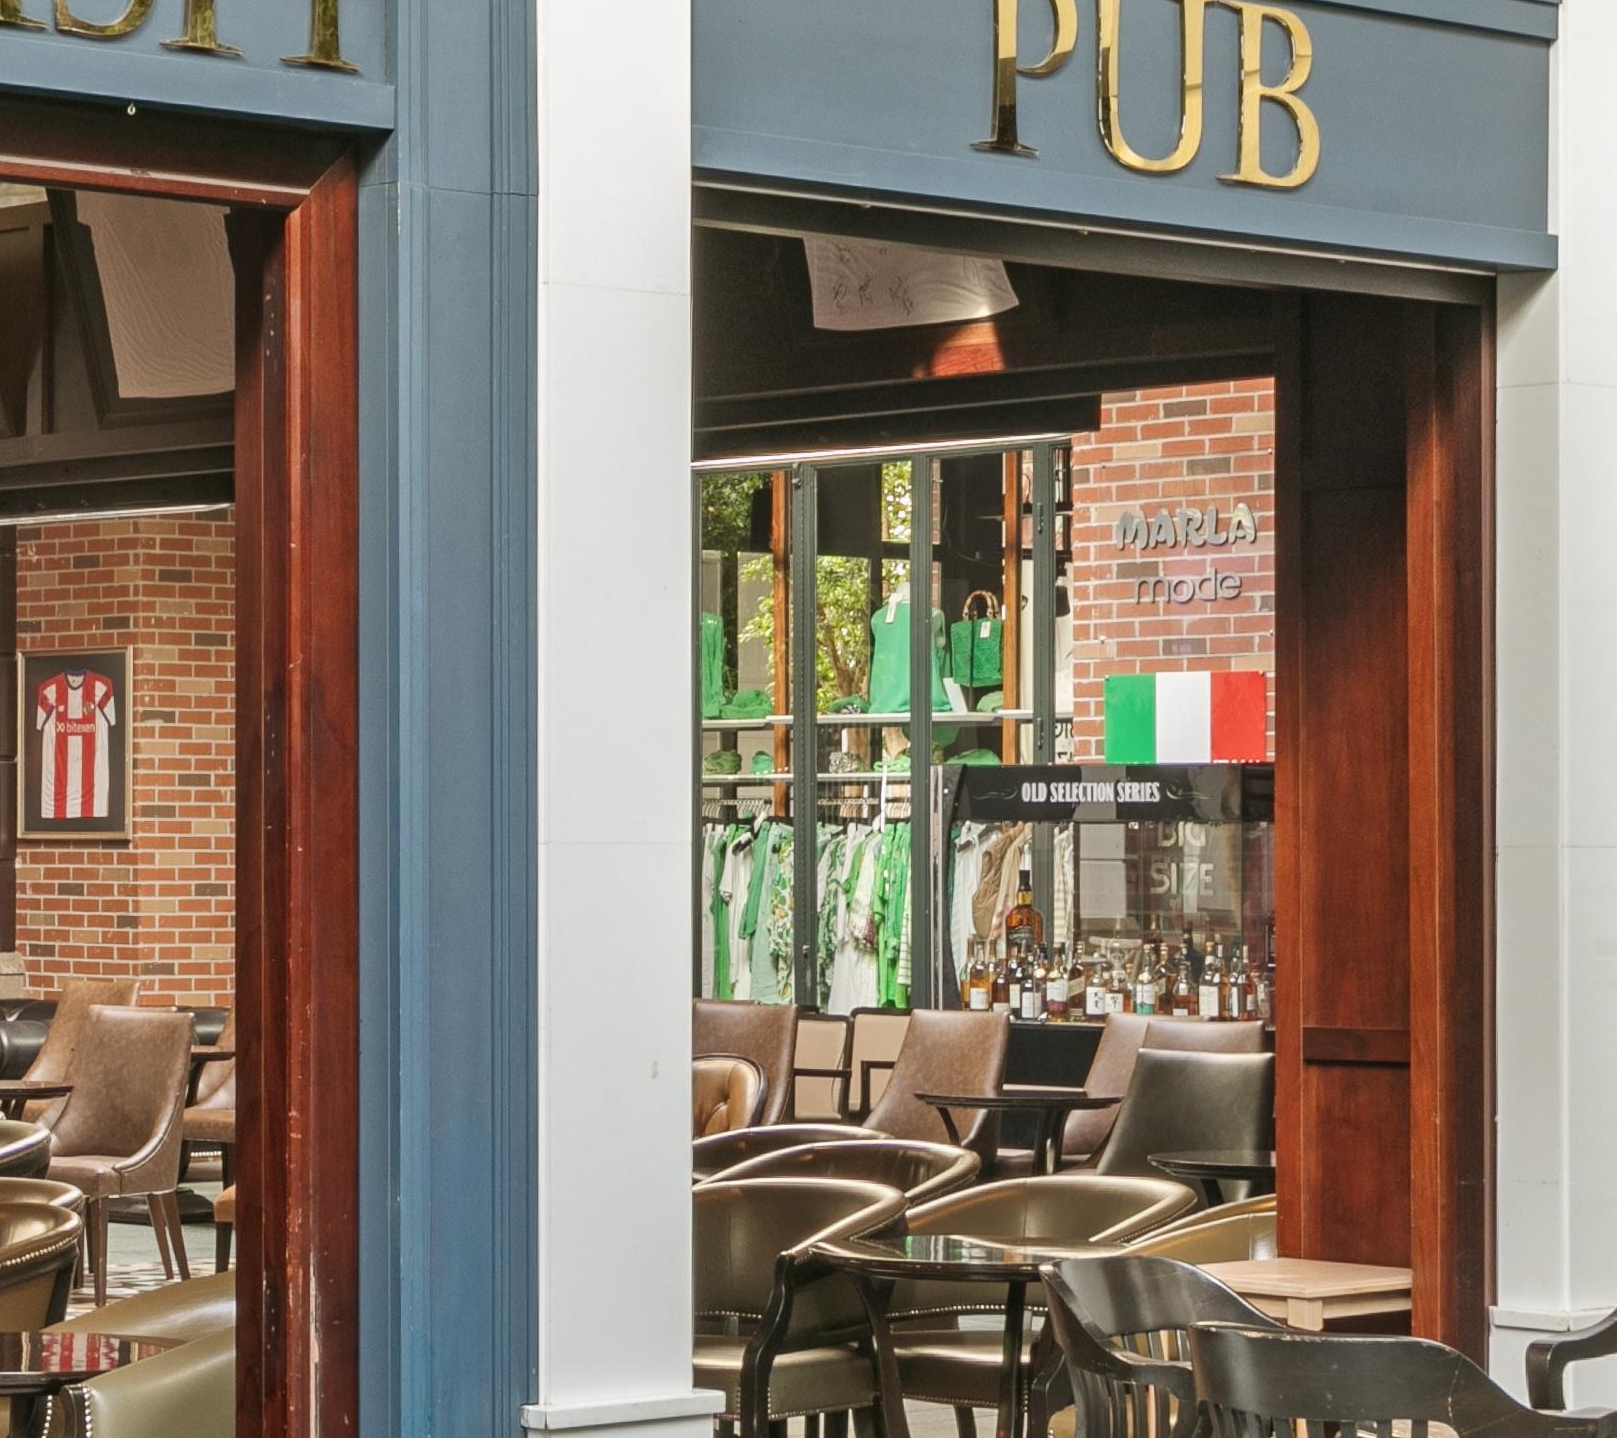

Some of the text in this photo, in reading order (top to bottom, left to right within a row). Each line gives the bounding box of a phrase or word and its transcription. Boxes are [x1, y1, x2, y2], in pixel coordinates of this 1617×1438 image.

[1115, 501, 1257, 551] MARLA
[1132, 568, 1243, 605] mode
[66, 721, 96, 733] bitexen
[1021, 781, 1161, 803] OLD SELECTION SERIES
[1150, 862, 1215, 895] SIZE
